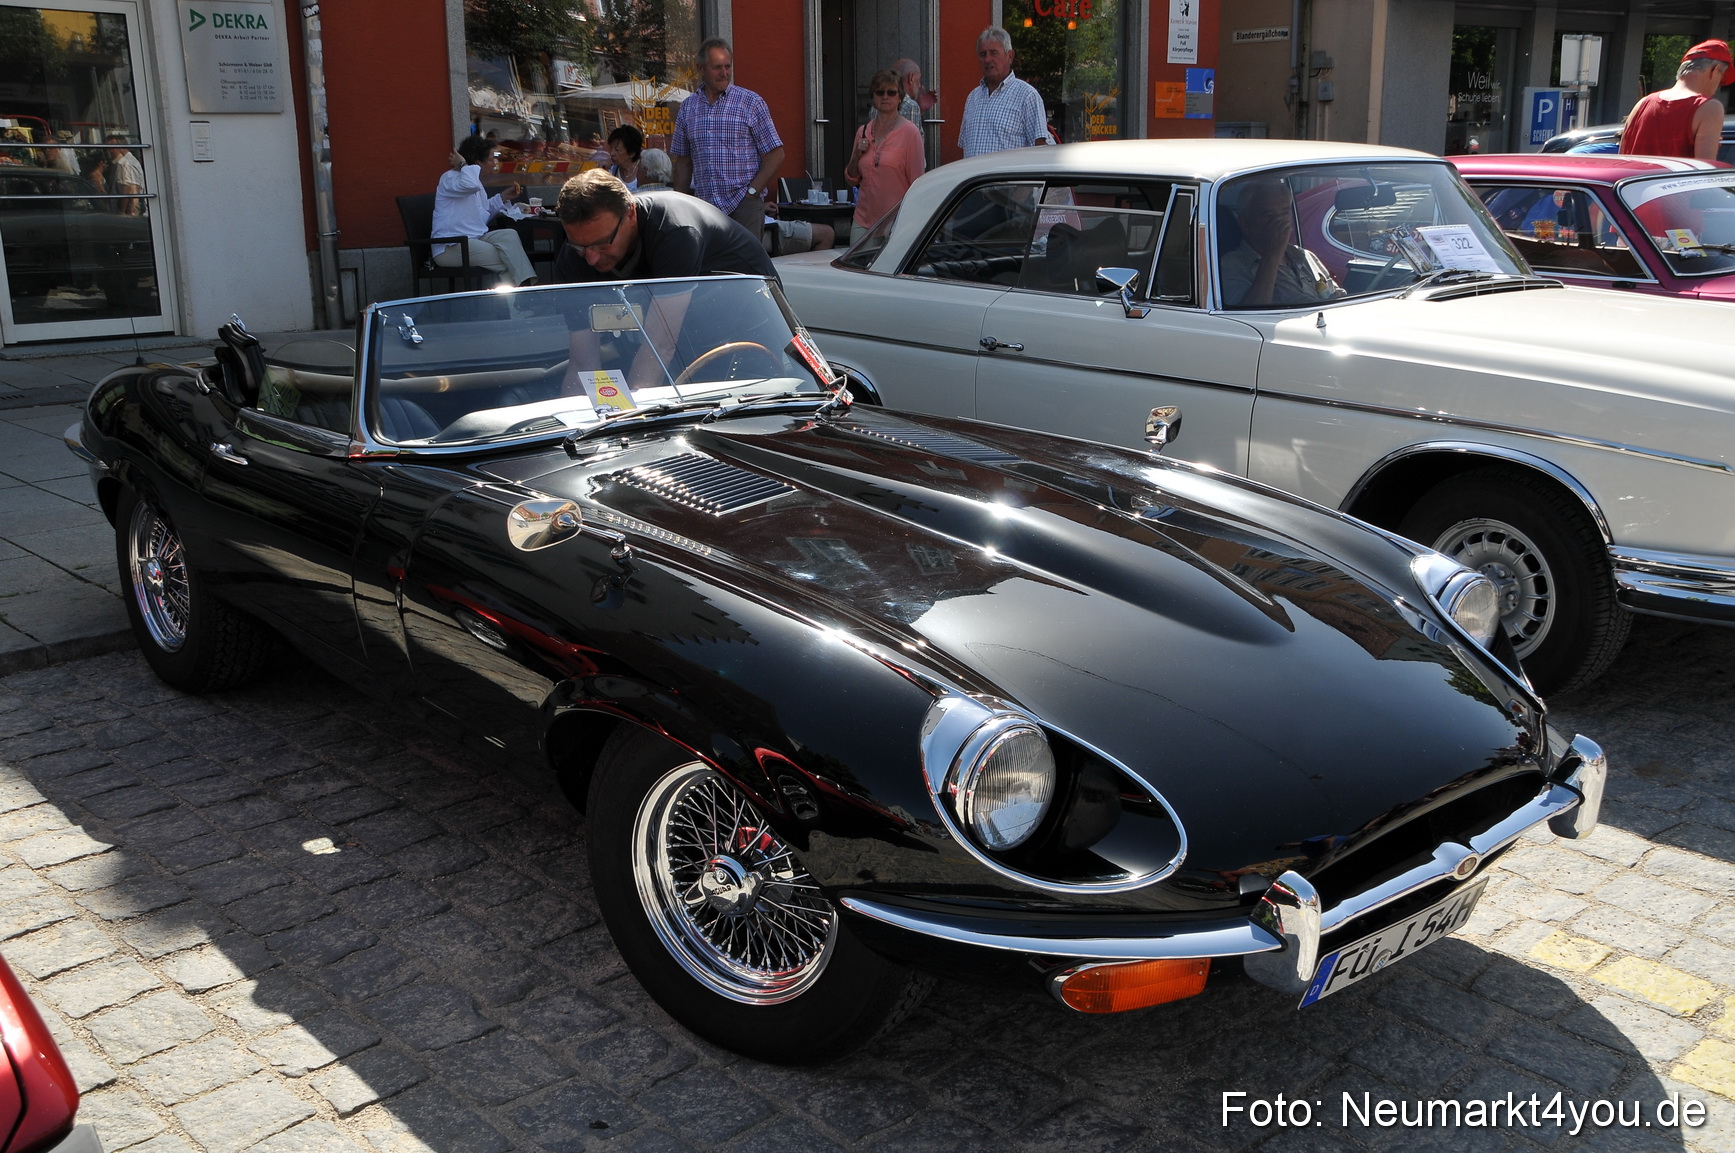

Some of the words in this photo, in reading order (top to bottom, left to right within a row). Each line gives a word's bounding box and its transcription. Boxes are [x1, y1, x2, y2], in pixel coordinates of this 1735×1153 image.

[213, 13, 268, 29] DEKRA
[1468, 72, 1490, 90] Weil
[1458, 92, 1480, 103] Schuhe
[1482, 92, 1501, 102] lieben
[646, 107, 670, 119] DER
[1538, 99, 1554, 123] P
[1091, 115, 1104, 124] DER
[1091, 125, 1117, 135] BÄCKER
[1451, 237, 1473, 250] 322
[1324, 937, 1382, 992] FÜ
[1389, 921, 1417, 960] I
[1414, 885, 1483, 947] 54H
[1309, 985, 1320, 996] D
